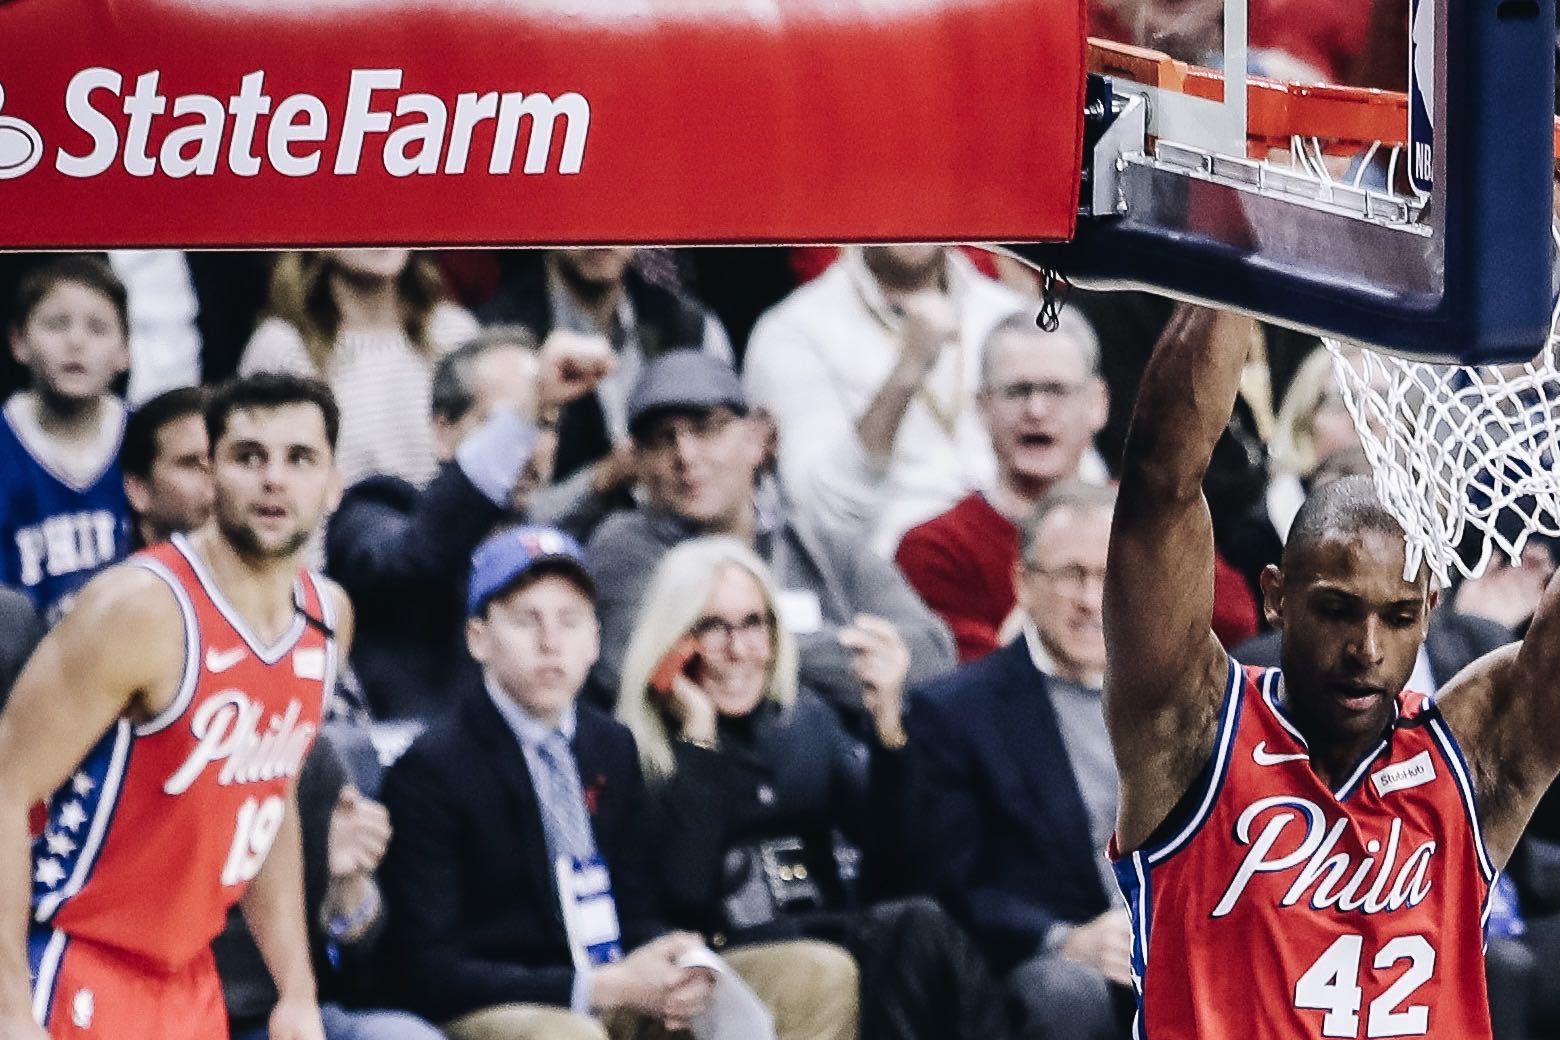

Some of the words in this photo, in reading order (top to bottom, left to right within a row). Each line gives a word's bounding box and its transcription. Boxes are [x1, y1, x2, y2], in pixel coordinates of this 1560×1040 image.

[164, 688, 316, 796] Phila
[220, 795, 286, 887] 19
[1211, 795, 1437, 917] Phila
[1294, 933, 1437, 1040] 42
